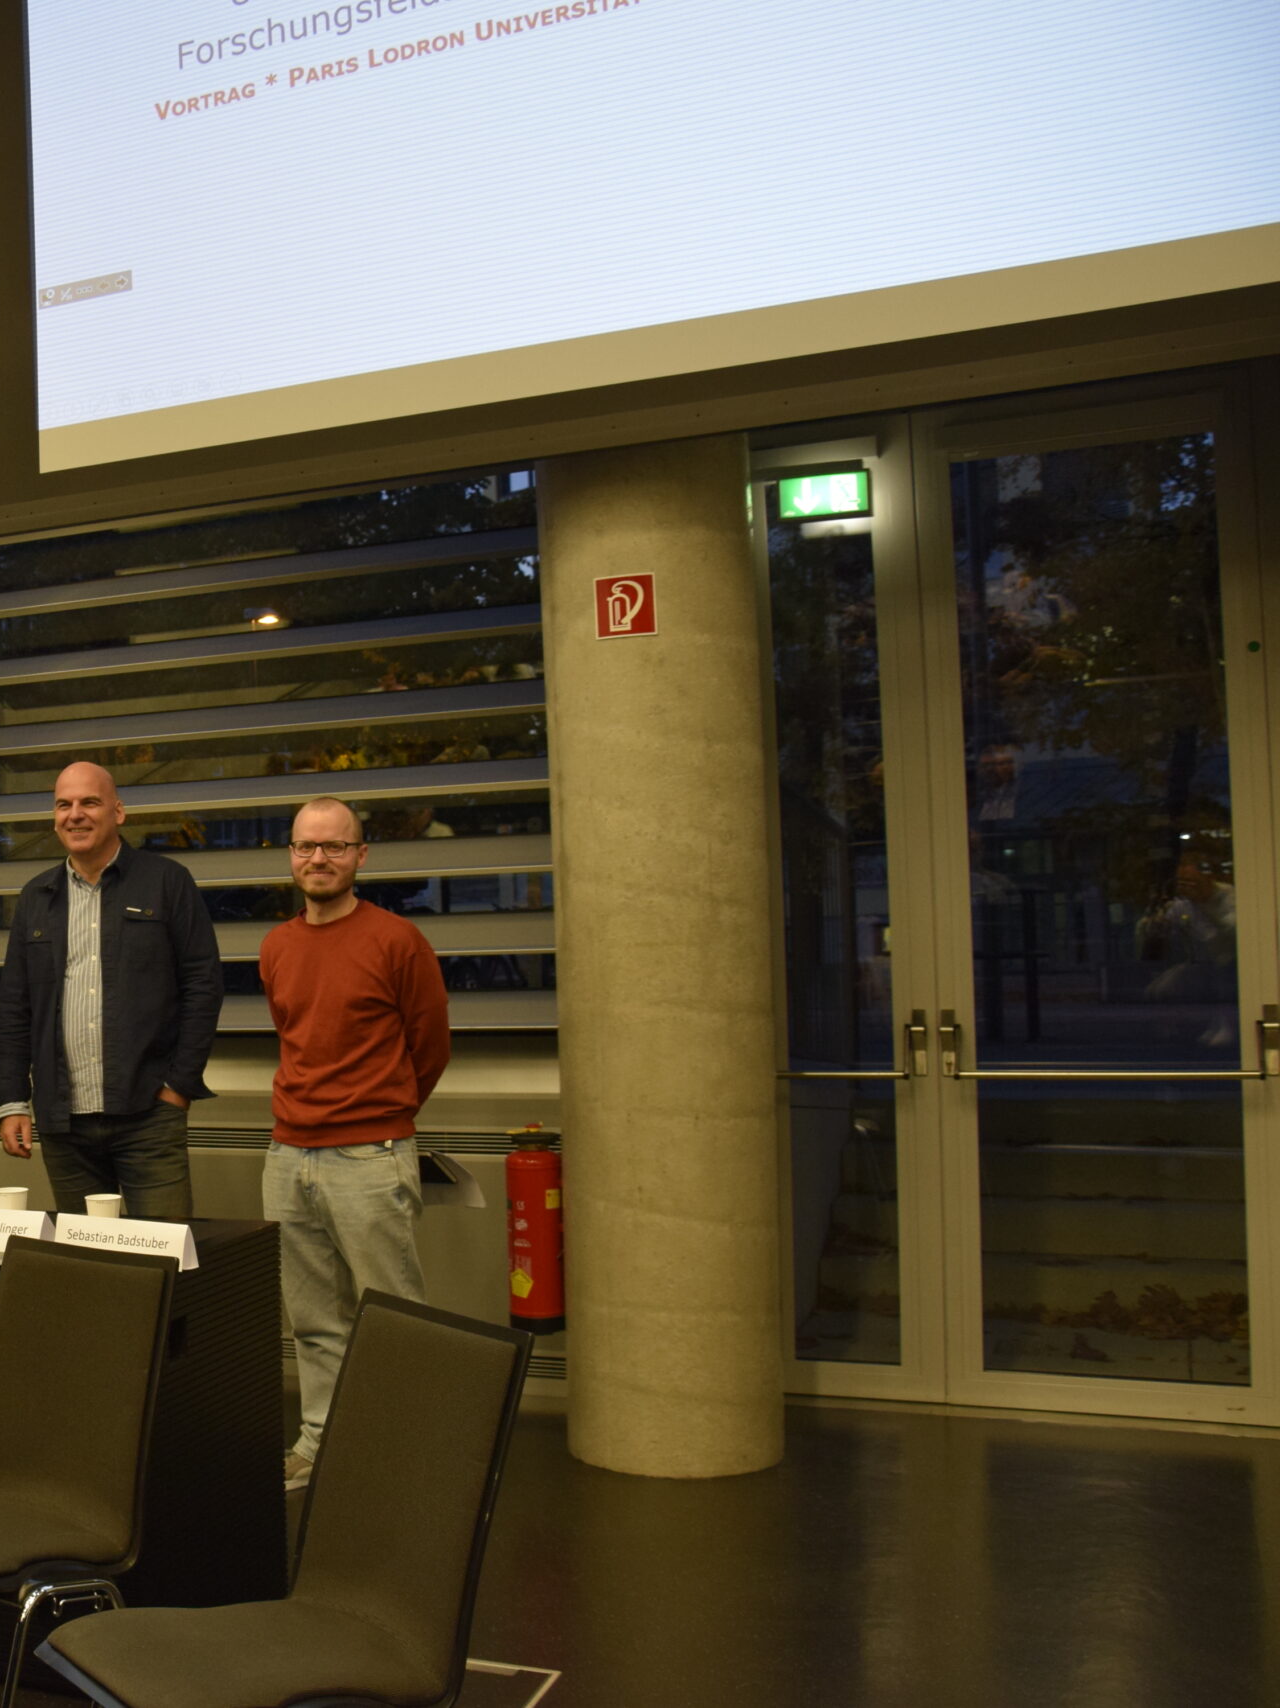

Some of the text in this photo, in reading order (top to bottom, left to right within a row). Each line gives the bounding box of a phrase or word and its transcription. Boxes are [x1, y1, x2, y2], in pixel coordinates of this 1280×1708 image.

[289, 57, 359, 88] PARIS
[368, 30, 466, 68] LODRON
[66, 1228, 170, 1249] Sebastian Badstuber
